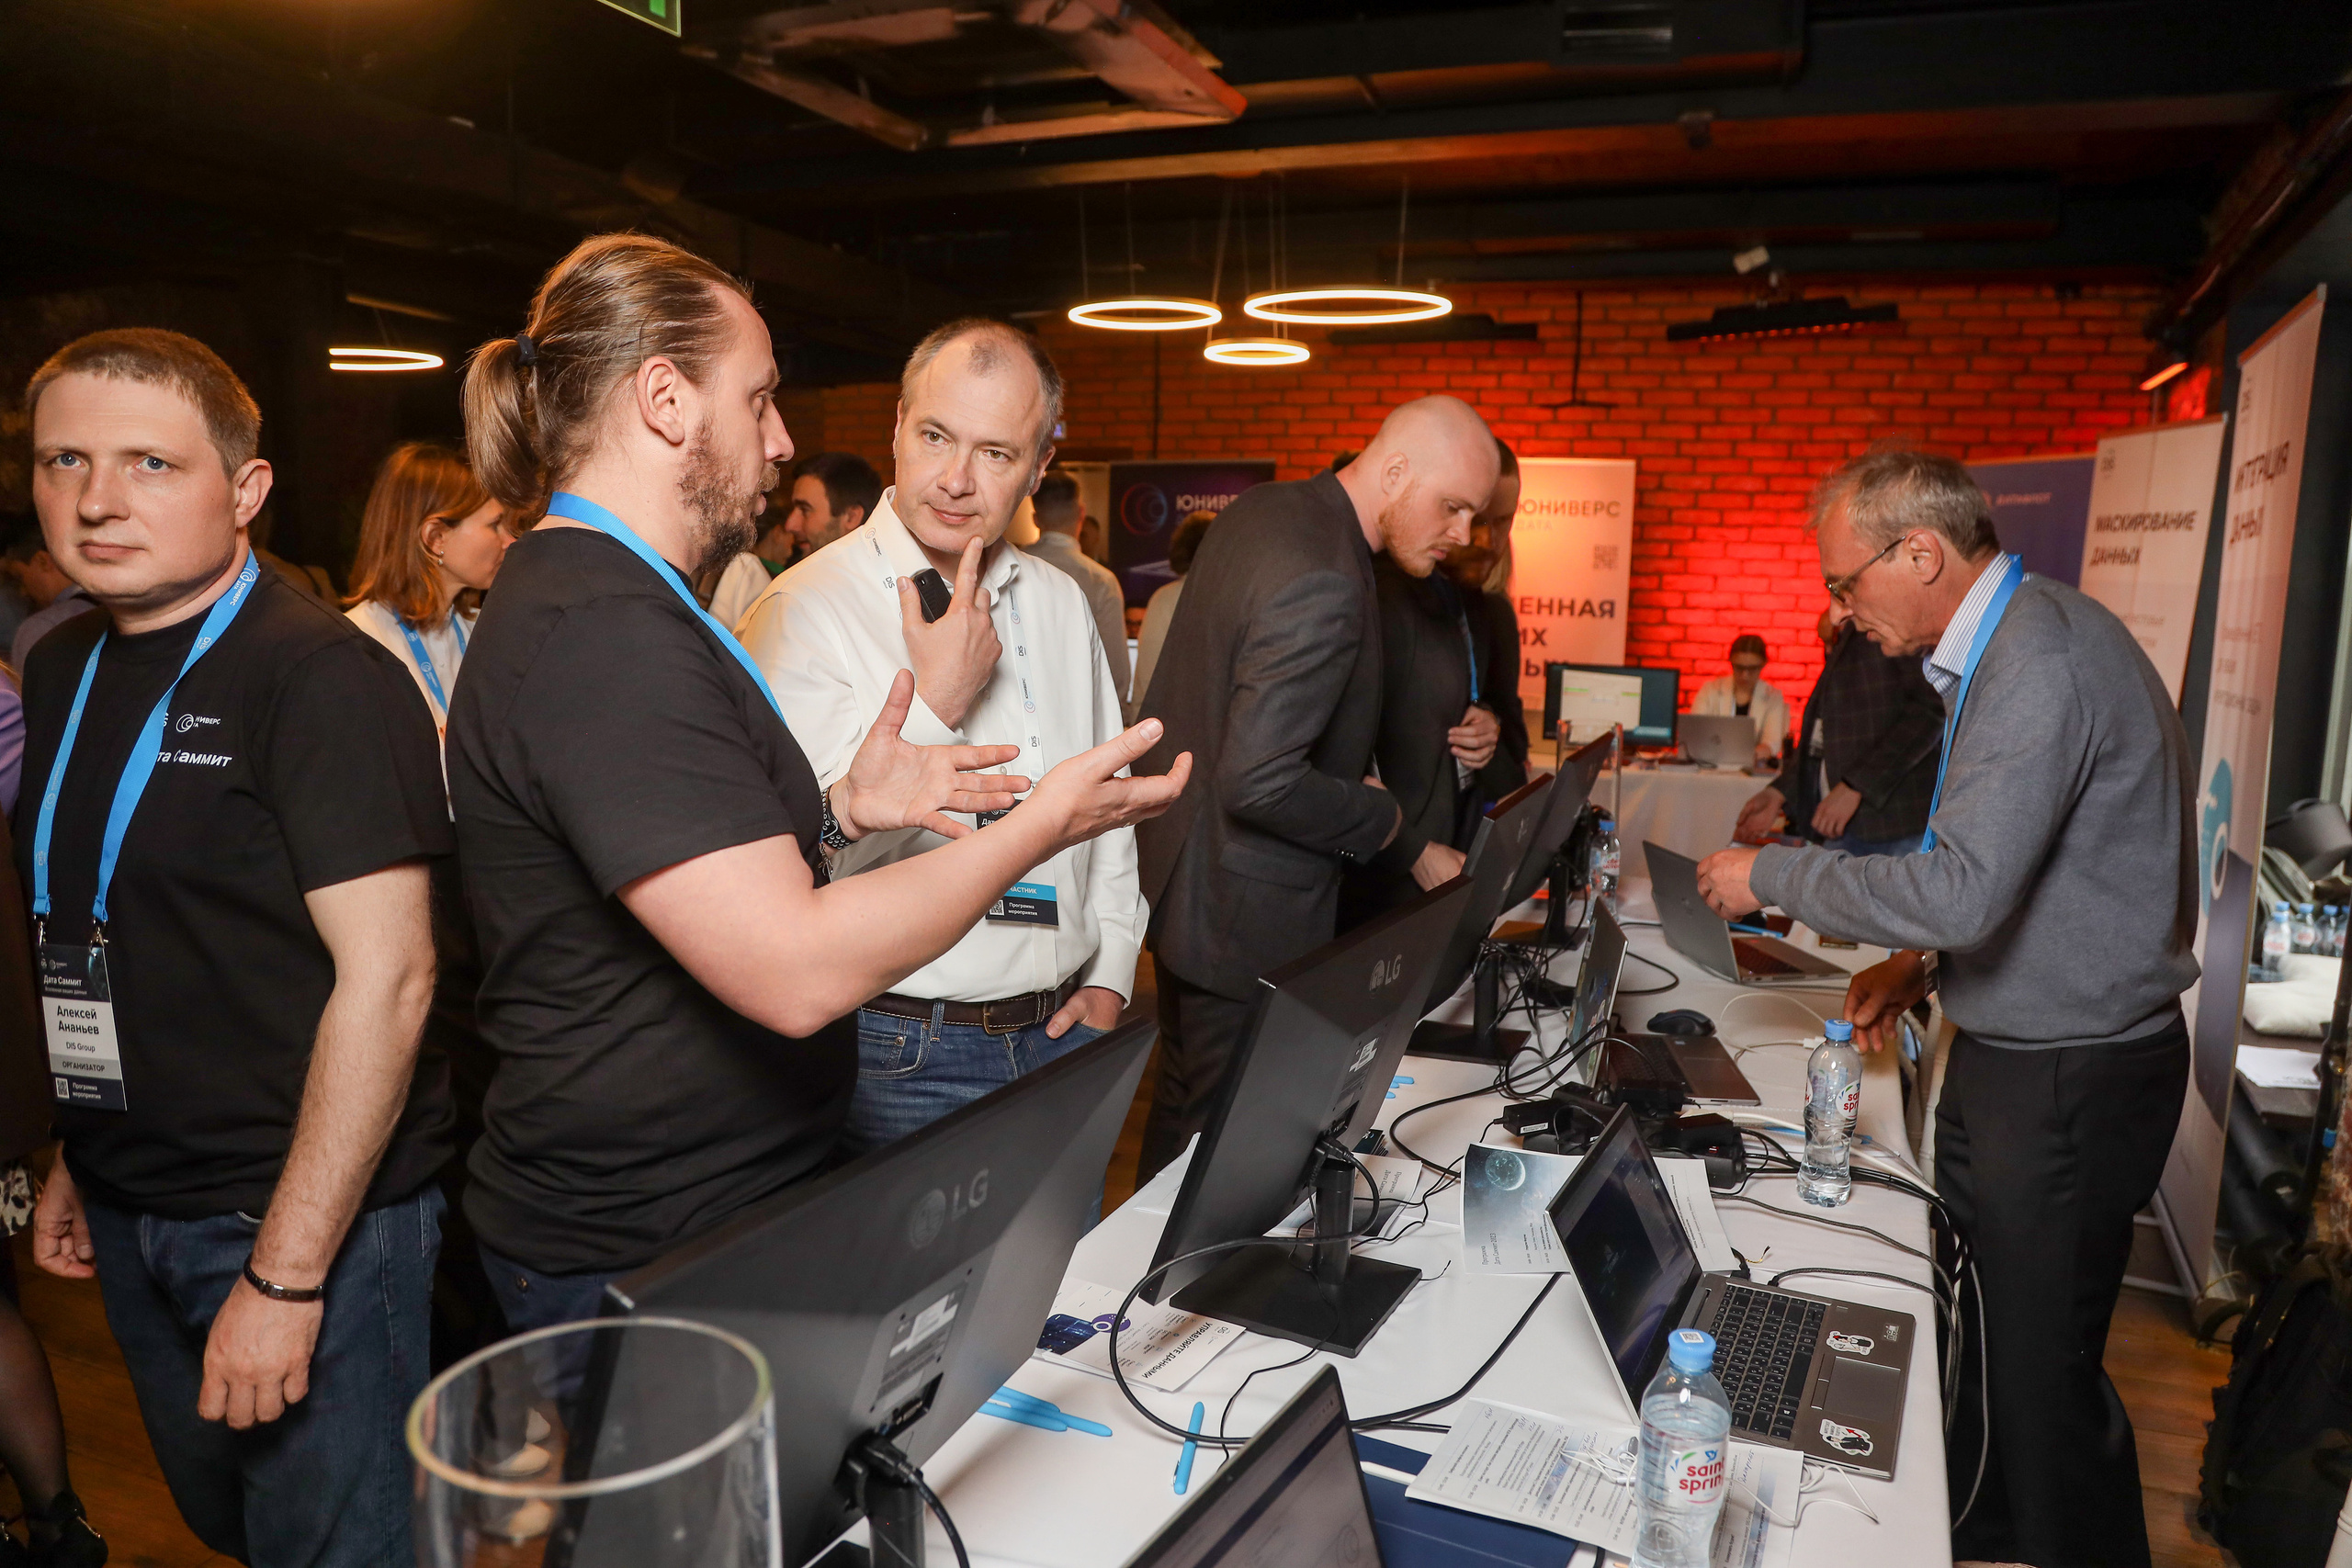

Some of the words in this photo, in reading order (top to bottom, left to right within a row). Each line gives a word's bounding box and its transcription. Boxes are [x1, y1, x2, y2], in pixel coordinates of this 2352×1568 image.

[2095, 510, 2198, 533] МАСКИРОВАНИЕ
[2089, 547, 2142, 567] ДАННЫХ
[885, 576, 895, 588] DIS
[230, 582, 247, 606] ЮНИВЕРС
[199, 637, 212, 649] DIS
[195, 716, 221, 725] НИВЕРС
[156, 751, 172, 762] та
[981, 818, 996, 827] Дат
[1010, 886, 1037, 895] ЧАСТНИК
[1385, 953, 1403, 986] LG
[43, 975, 57, 985] Дата
[58, 976, 82, 987] Саммит
[57, 1005, 97, 1020] Алексей
[58, 1021, 100, 1035] Ананьев
[66, 1042, 76, 1050] DIS
[77, 1043, 96, 1053] Group
[62, 1061, 106, 1072] ОРГАНИЗАТОР
[73, 1082, 98, 1091] Программа
[73, 1091, 101, 1100] мероприятия
[952, 1168, 989, 1222] LG
[1480, 1246, 1489, 1265] Программа
[1217, 1326, 1228, 1335] DIS
[1174, 1323, 1214, 1355] УПРАВЛЯЙТЕ
[1142, 1352, 1177, 1379] ДАННЫМИ
[1679, 1474, 1723, 1495] sprin
